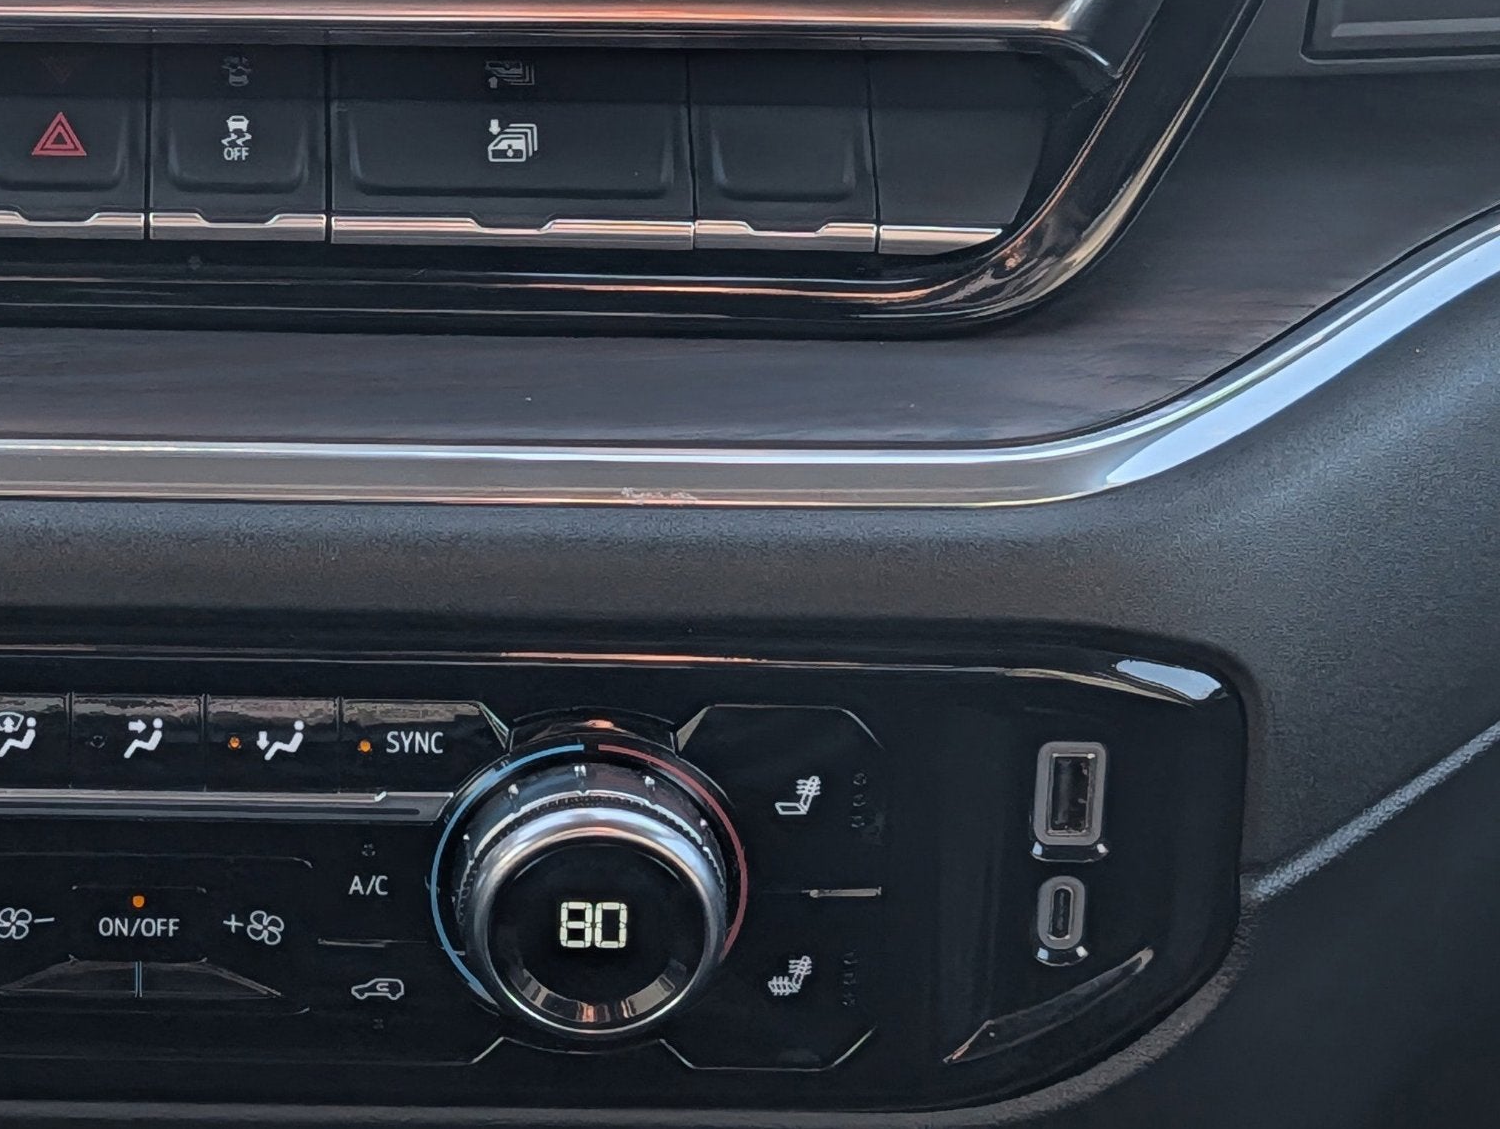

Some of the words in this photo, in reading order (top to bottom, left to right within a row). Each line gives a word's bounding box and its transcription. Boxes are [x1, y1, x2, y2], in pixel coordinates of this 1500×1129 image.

[223, 147, 250, 161] OFF
[385, 731, 444, 755] SYNC
[348, 876, 389, 896] A/C
[98, 916, 181, 938] ON/OFF
[559, 901, 628, 949] 80
